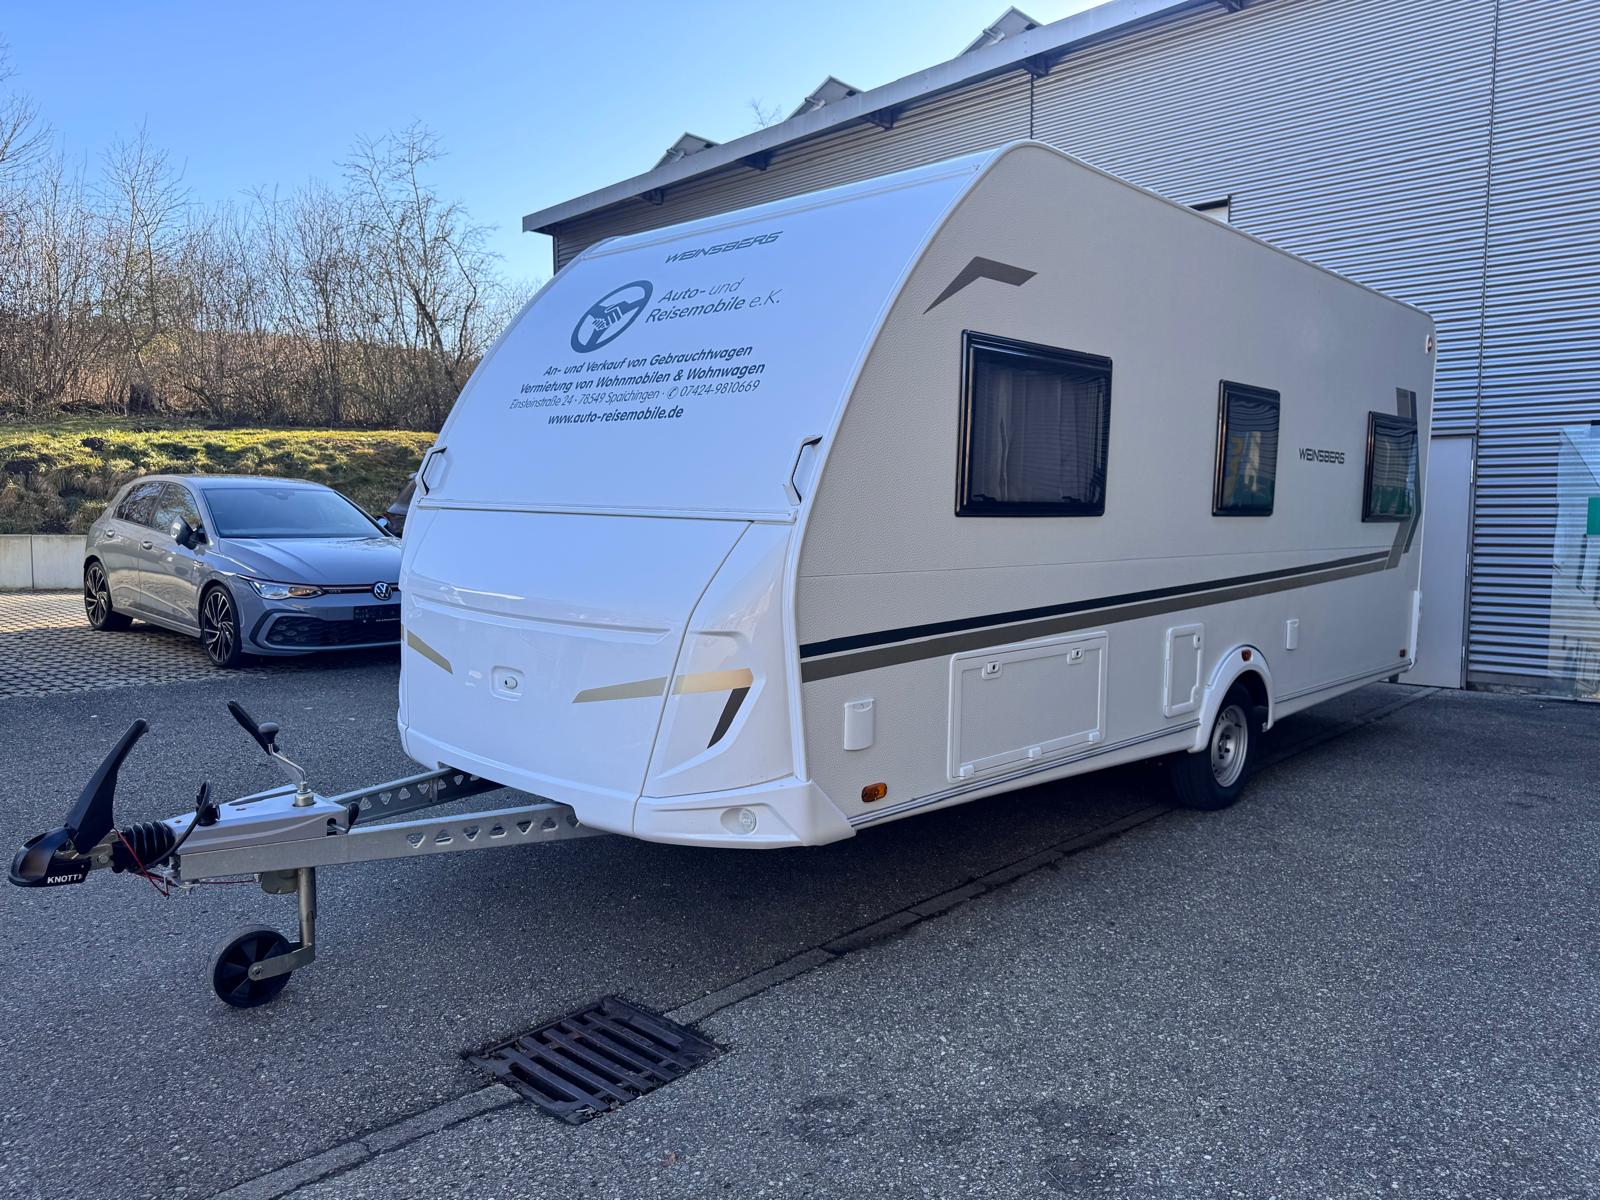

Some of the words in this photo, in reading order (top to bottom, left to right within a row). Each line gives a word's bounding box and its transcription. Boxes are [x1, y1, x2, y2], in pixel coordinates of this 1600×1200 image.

[665, 231, 783, 263] WEINSBERG
[658, 287, 705, 303] Auto-
[709, 278, 744, 295] und
[645, 296, 745, 323] Reisemobile
[749, 289, 783, 308] e.K.
[543, 365, 562, 376] An-
[564, 362, 585, 374] und
[586, 358, 627, 372] Verkauf
[627, 358, 647, 368] von
[650, 346, 753, 366] Gebrauchtwagen
[520, 381, 573, 394] Vermietung
[575, 380, 594, 390] von
[596, 371, 671, 388] Wohnmobilen
[673, 369, 684, 381] &
[687, 363, 766, 380] Wohnwagen
[509, 395, 561, 409] Einsteinstraße
[562, 394, 574, 406] 24
[578, 392, 606, 405] 78549
[606, 389, 660, 405] Spaichingen
[680, 379, 761, 397] 07424-9810669
[548, 405, 684, 424] www.auto-reisemobile.de
[1299, 447, 1345, 465] WEINSBERG
[47, 873, 79, 884] KNOTT
